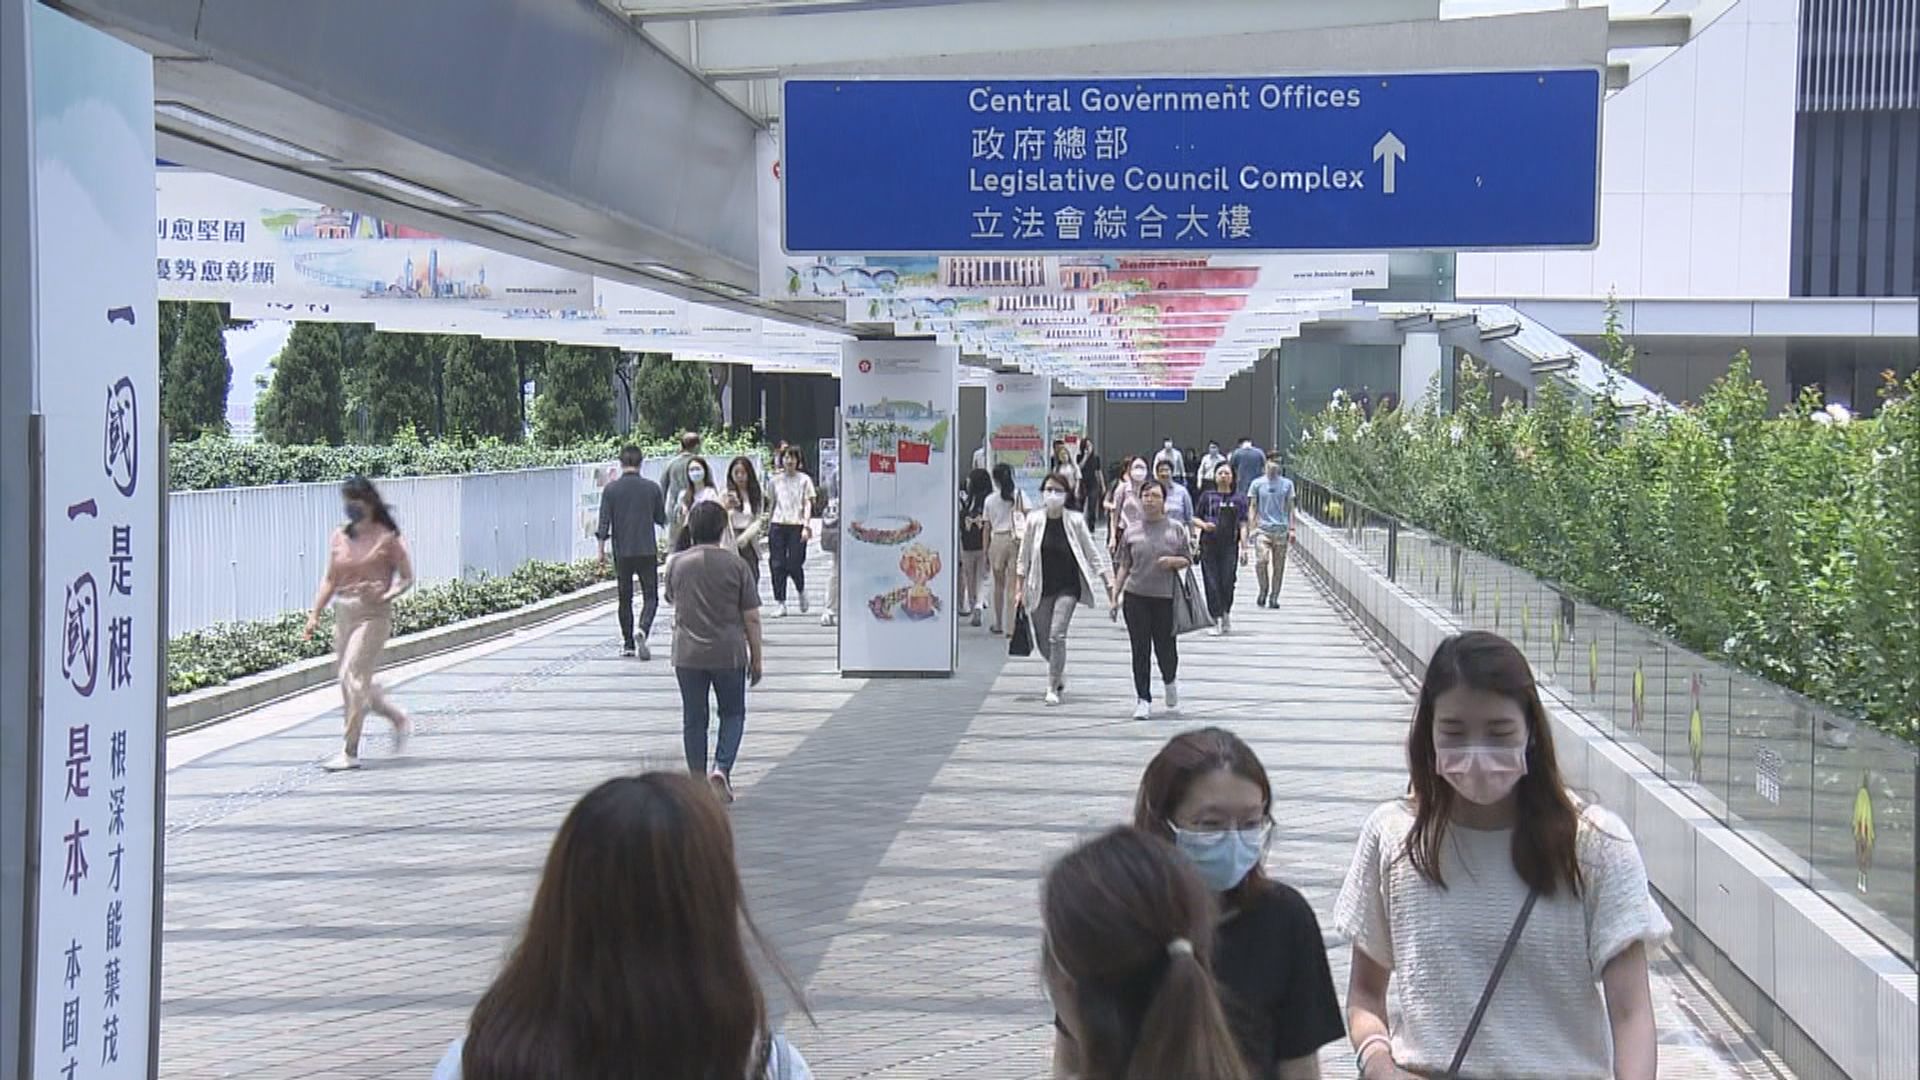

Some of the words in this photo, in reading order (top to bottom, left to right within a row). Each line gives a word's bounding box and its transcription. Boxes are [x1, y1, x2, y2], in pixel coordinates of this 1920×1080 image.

[969, 87, 1071, 112] Central
[1081, 87, 1250, 112] Government
[1260, 84, 1361, 109] Offices
[971, 126, 1128, 160] 政府總部
[970, 168, 1115, 197] Legislative
[1125, 167, 1229, 191] Council
[1239, 165, 1364, 193] Complex
[970, 204, 1252, 240] 立法會綜合大樓
[103, 305, 138, 691] 一國是根
[62, 498, 99, 896] 一國是本
[101, 729, 126, 1067] 根深才能葉茂
